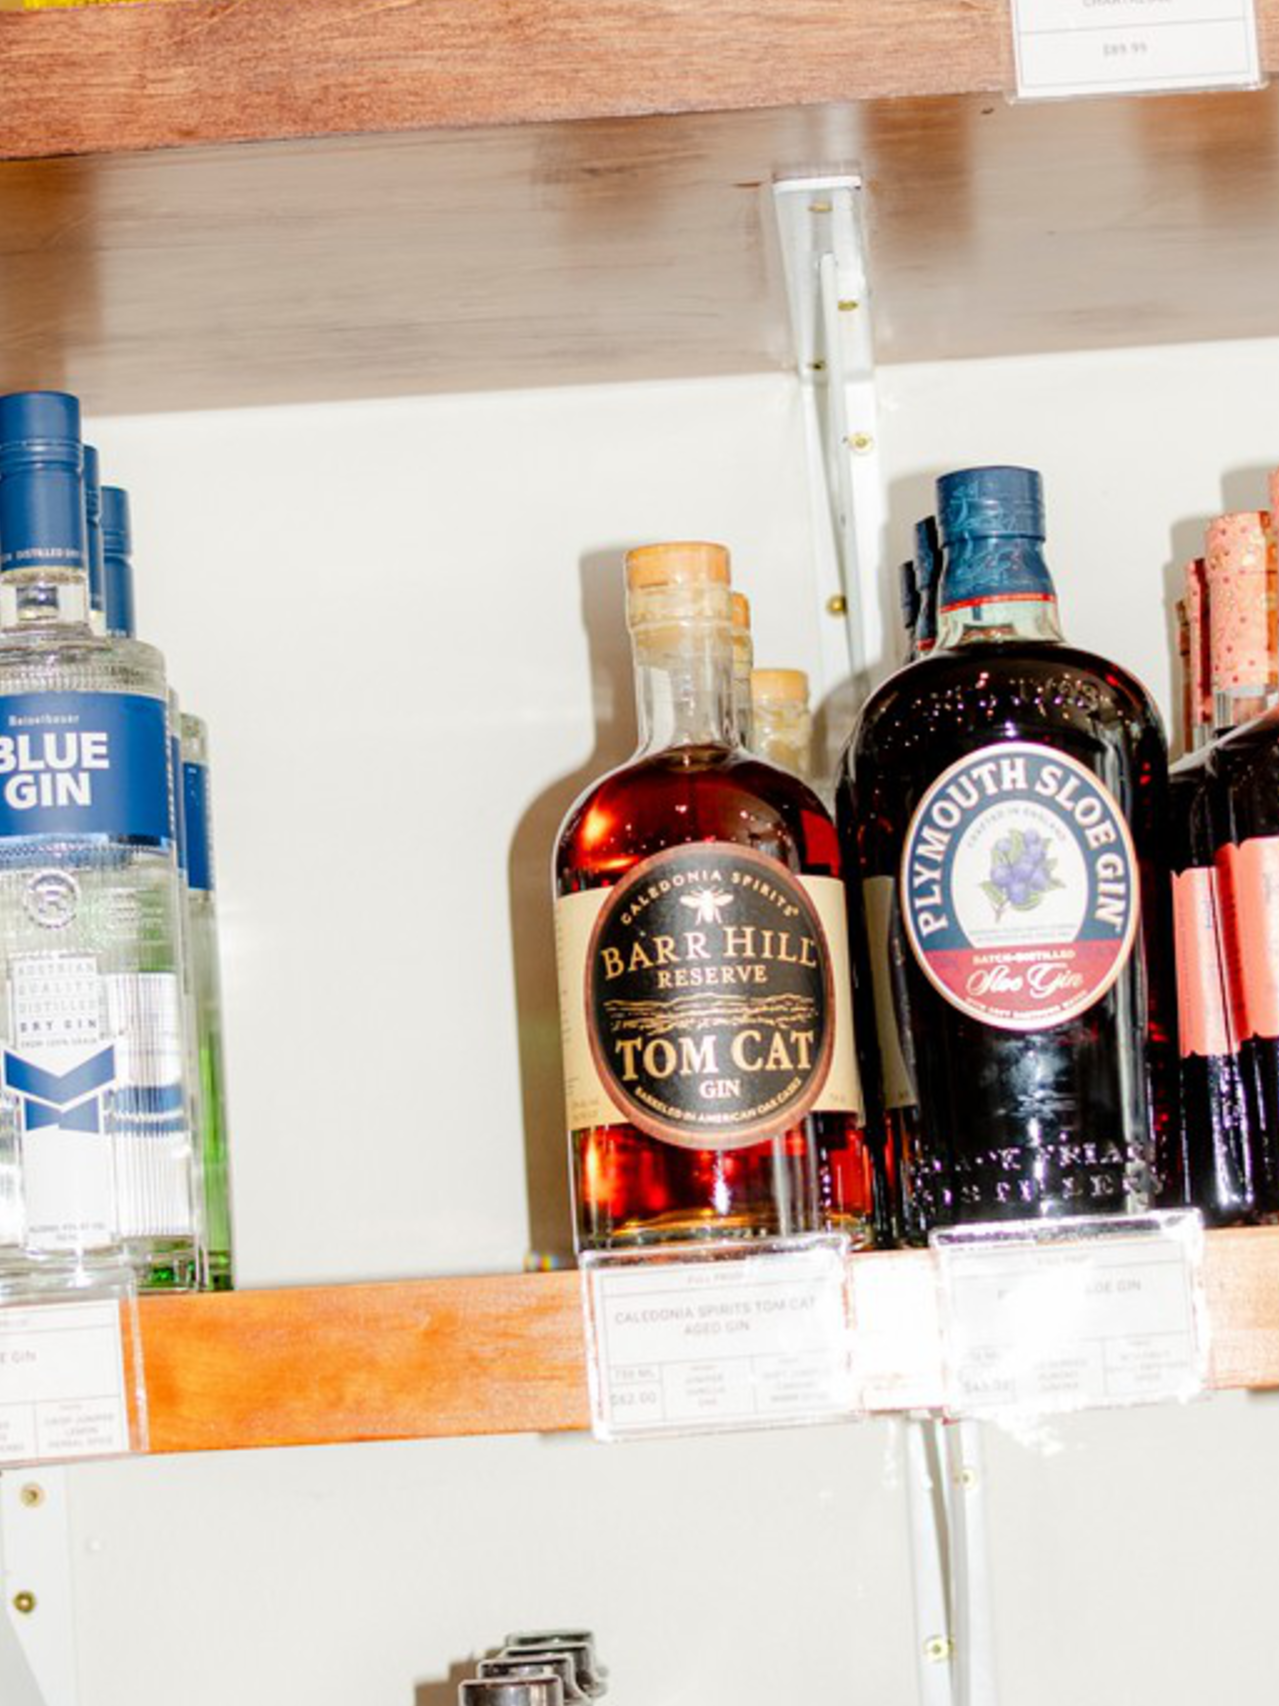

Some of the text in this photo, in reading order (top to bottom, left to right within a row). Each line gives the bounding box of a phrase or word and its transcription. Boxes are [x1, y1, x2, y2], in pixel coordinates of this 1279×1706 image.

[4, 773, 92, 809] GIN
[913, 757, 1127, 937] PLYMOUTH SLOE GIN
[620, 870, 722, 925] CALEDONIA
[600, 926, 818, 981] BARR HILL
[657, 965, 768, 989] RESERVE
[615, 1030, 814, 1081] TOM CAT
[699, 1079, 741, 1099] GIN
